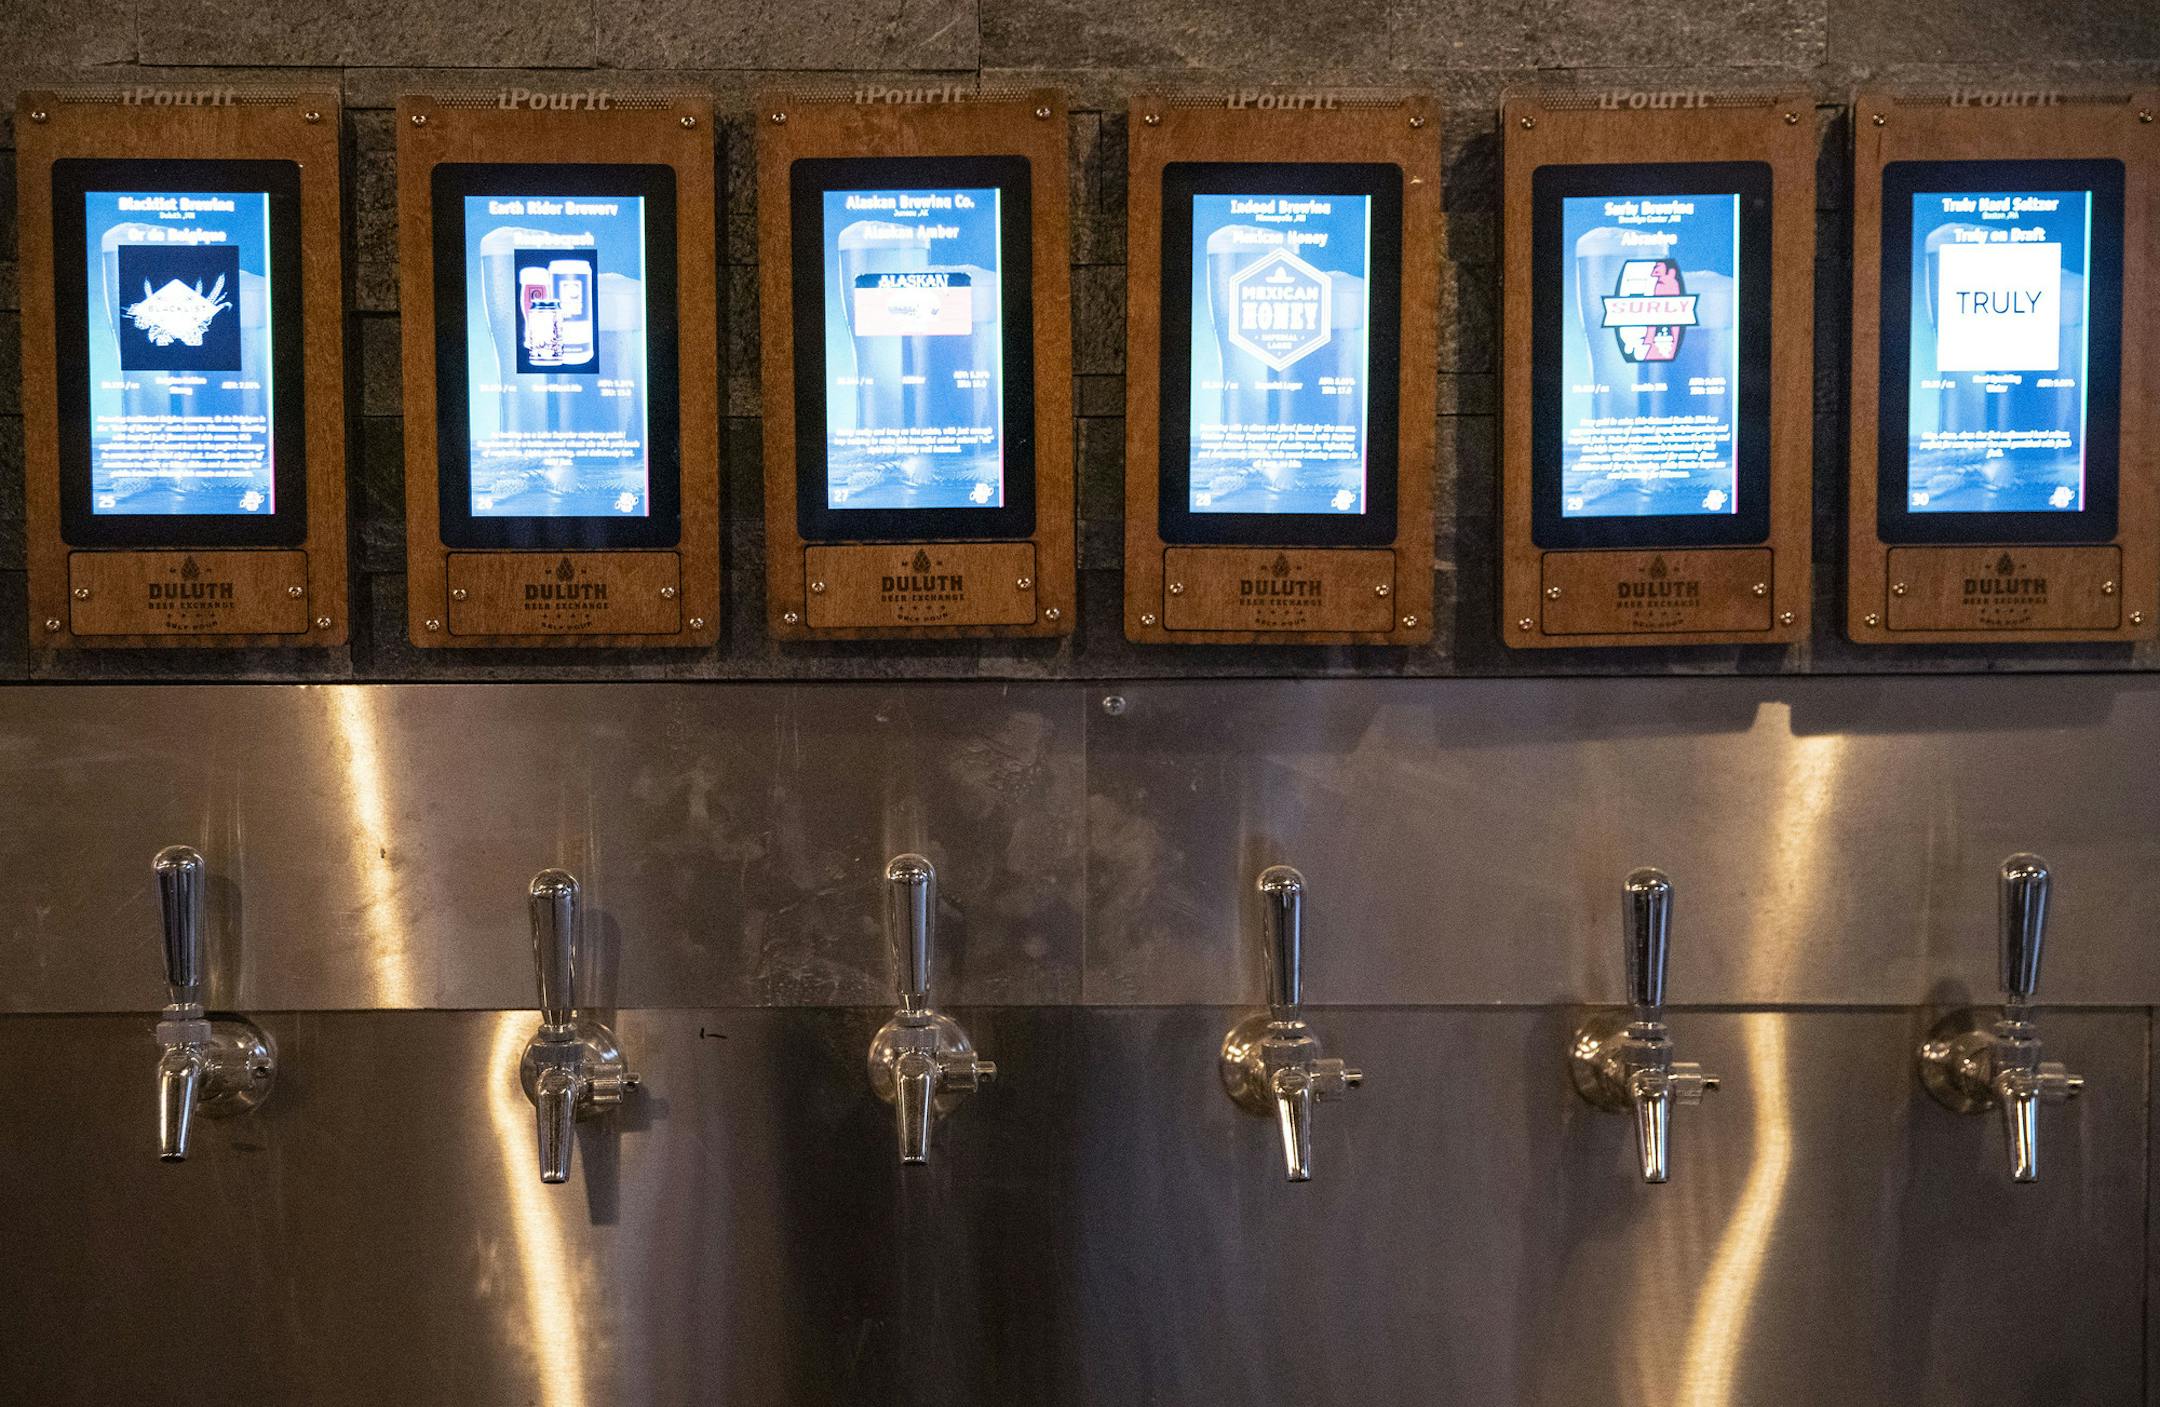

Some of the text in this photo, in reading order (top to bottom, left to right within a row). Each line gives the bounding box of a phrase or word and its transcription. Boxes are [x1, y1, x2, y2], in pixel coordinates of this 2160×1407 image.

[498, 86, 610, 110] iPourIt
[118, 197, 235, 212] Blacklist Brewing
[489, 201, 618, 216] Earth Rider Brewery
[846, 194, 975, 210] Alaskan Brewing Co.
[1230, 199, 1331, 215] Indeed Brewing
[1604, 200, 1694, 216] Surly Brewing
[1942, 197, 2059, 212] Truly Hard Seltzer
[917, 225, 959, 240] Amber
[1287, 230, 1328, 248] Honey
[1954, 227, 2046, 243] Truly on Draft
[878, 274, 950, 288] ALASKAN
[1241, 286, 1319, 301] MEXICAN
[1611, 300, 1689, 313] SURLY
[1956, 291, 2042, 314] TRULY
[1241, 302, 1318, 330] HONEY
[832, 488, 848, 503] 27
[1912, 492, 1930, 506] 30
[149, 583, 233, 599] DULUTH
[882, 575, 963, 592] DULUTH
[1240, 580, 1322, 596] DULUTH
[1618, 581, 1699, 598] DULUTH
[1964, 579, 2047, 594] DULUTH
[525, 584, 608, 600] DULUTH
